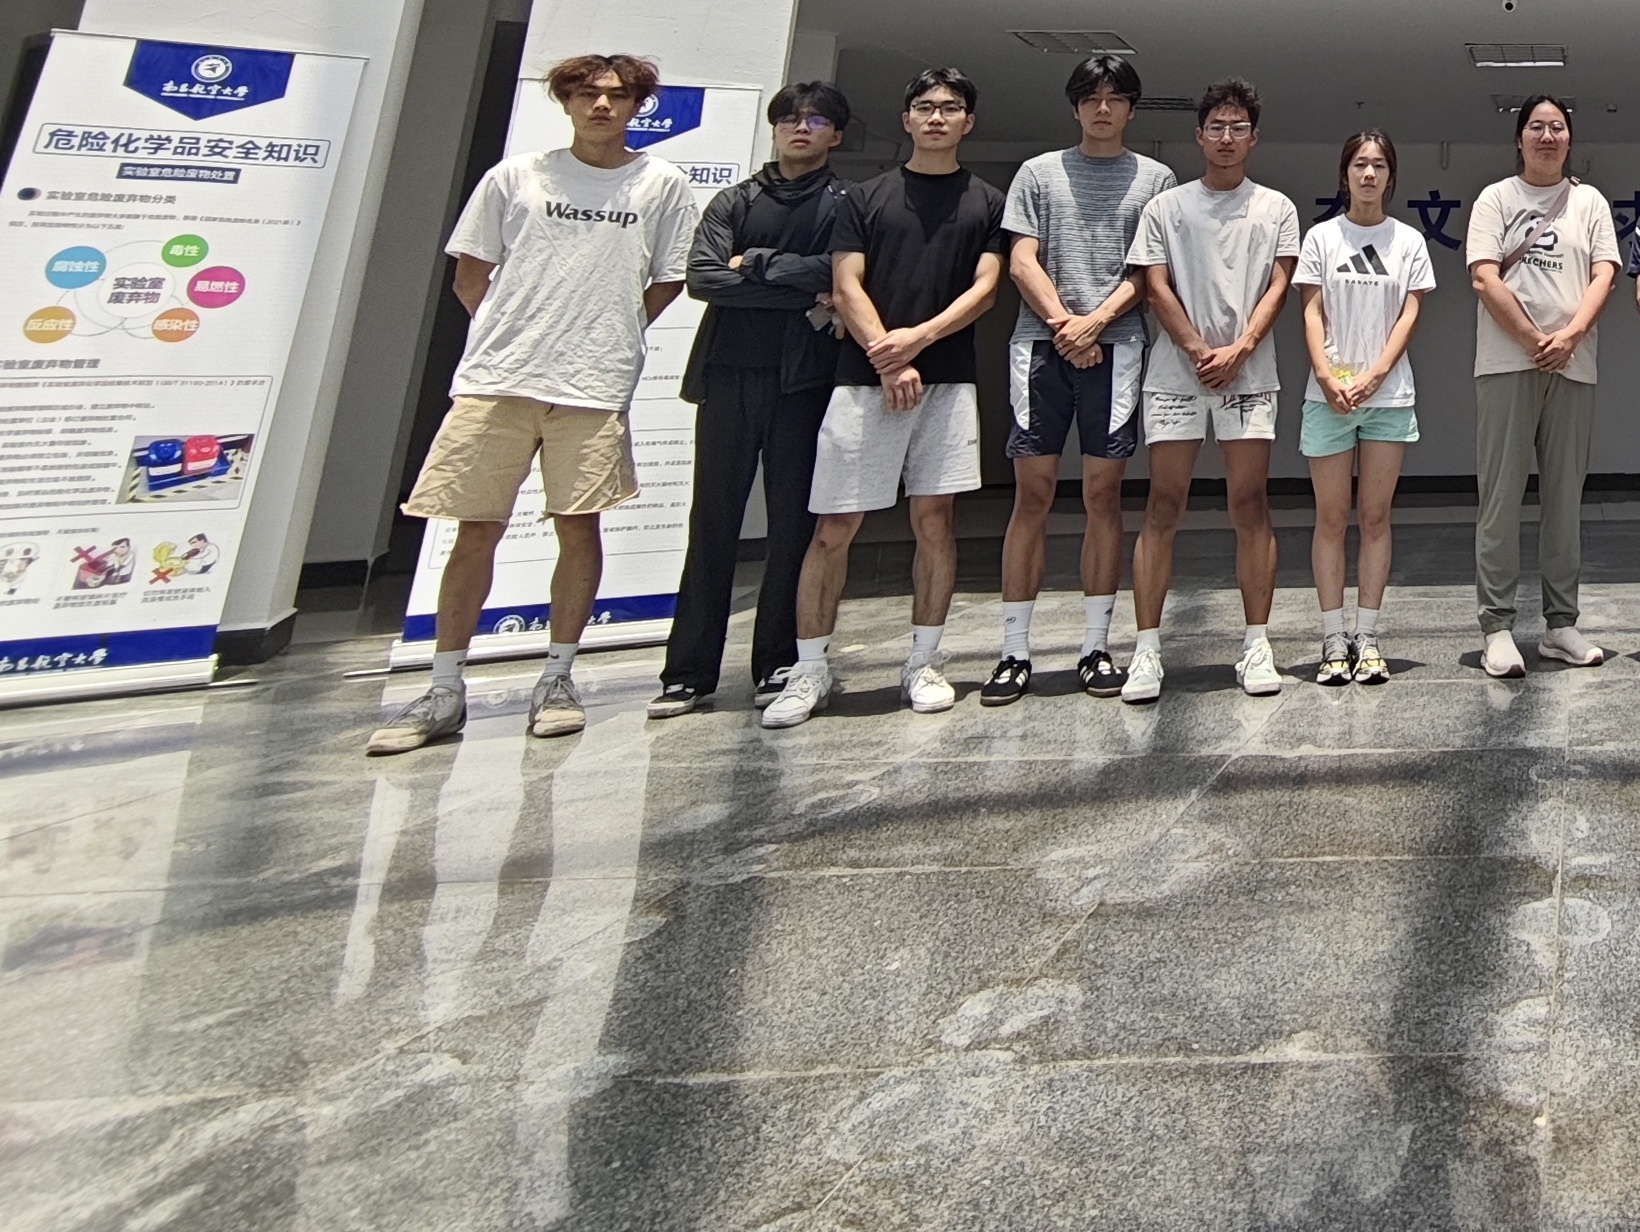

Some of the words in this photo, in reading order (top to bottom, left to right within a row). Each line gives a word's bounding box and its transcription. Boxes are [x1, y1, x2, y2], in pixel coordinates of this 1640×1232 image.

[43, 128, 321, 164] 危险化学品安全知识
[122, 166, 236, 181] 实验室危险废物处置
[676, 165, 733, 186] 知识
[546, 201, 639, 229] Wassup
[169, 244, 200, 257] 毒性
[1519, 256, 1563, 271] KECHERS
[112, 276, 166, 290] 实验室
[194, 280, 240, 294] 易燃性
[107, 292, 162, 305] 废弃物
[24, 319, 75, 331] 反应性
[152, 319, 200, 331] 感染性
